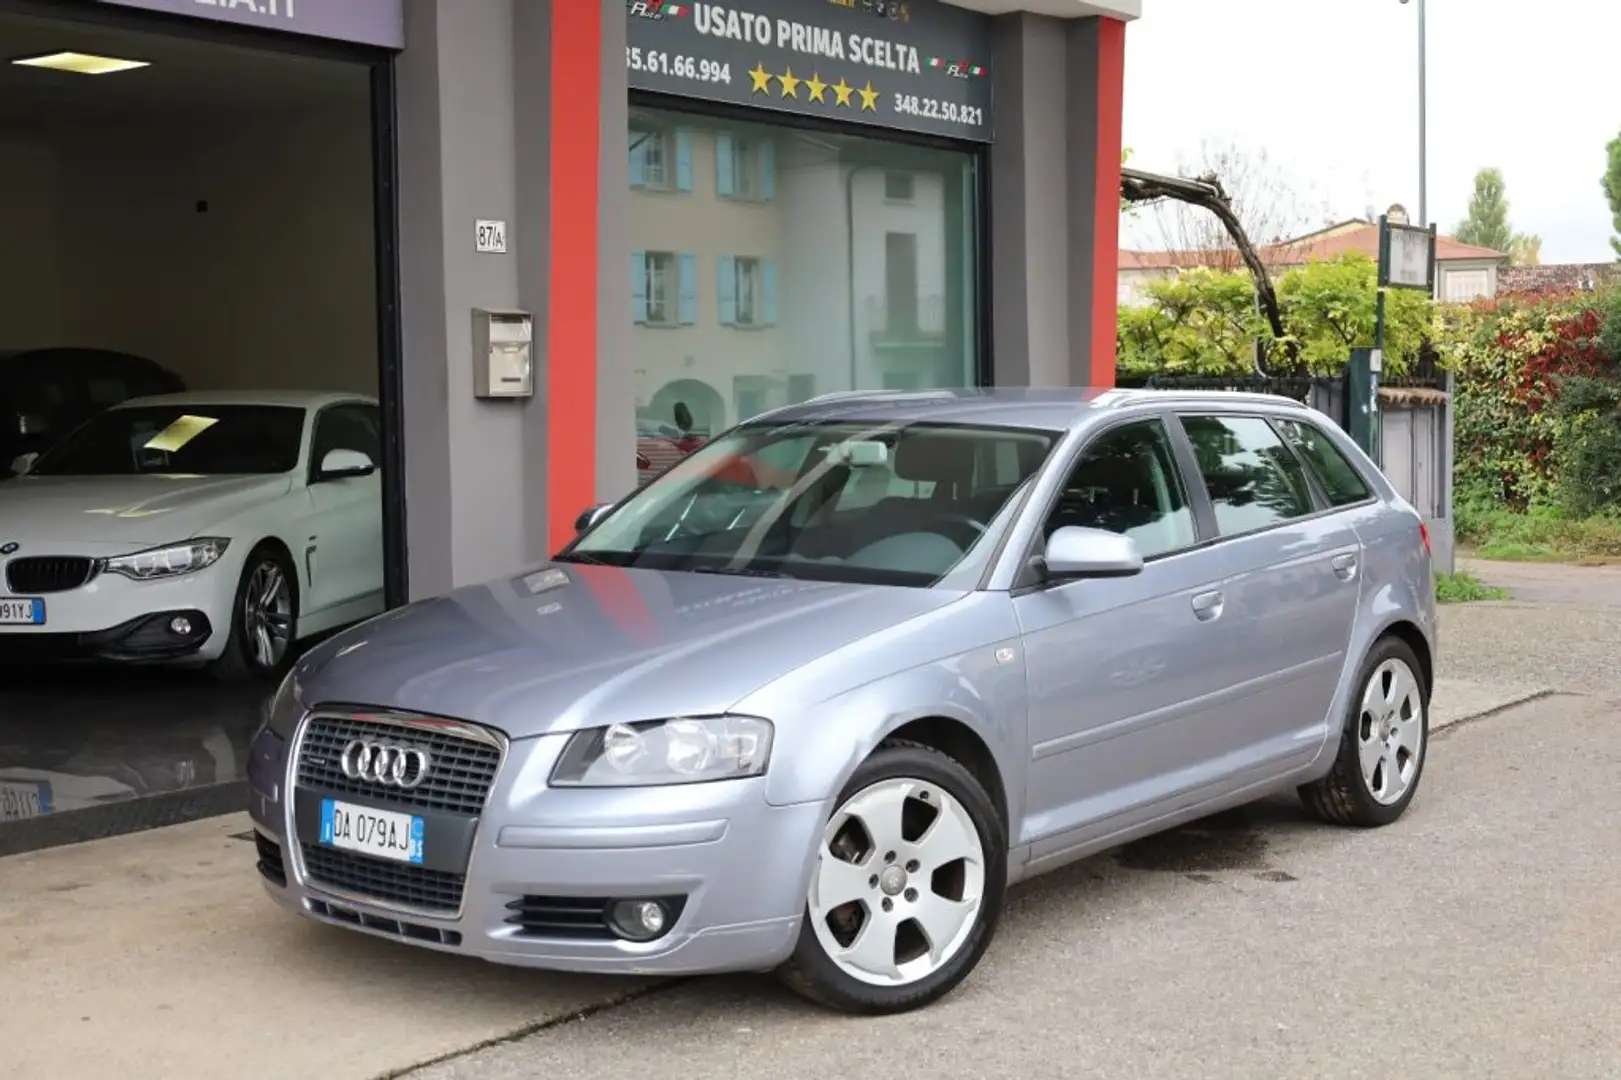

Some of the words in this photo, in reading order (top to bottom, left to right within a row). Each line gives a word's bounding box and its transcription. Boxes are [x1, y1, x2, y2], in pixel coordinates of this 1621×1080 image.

[694, 2, 772, 46] USATO
[777, 19, 844, 60] PRIMA
[848, 34, 920, 75] SCELTA
[894, 93, 982, 126] 348.22.50.821
[479, 226, 503, 248] 87/A
[334, 809, 350, 840] DA
[357, 814, 410, 850] 079AJ
